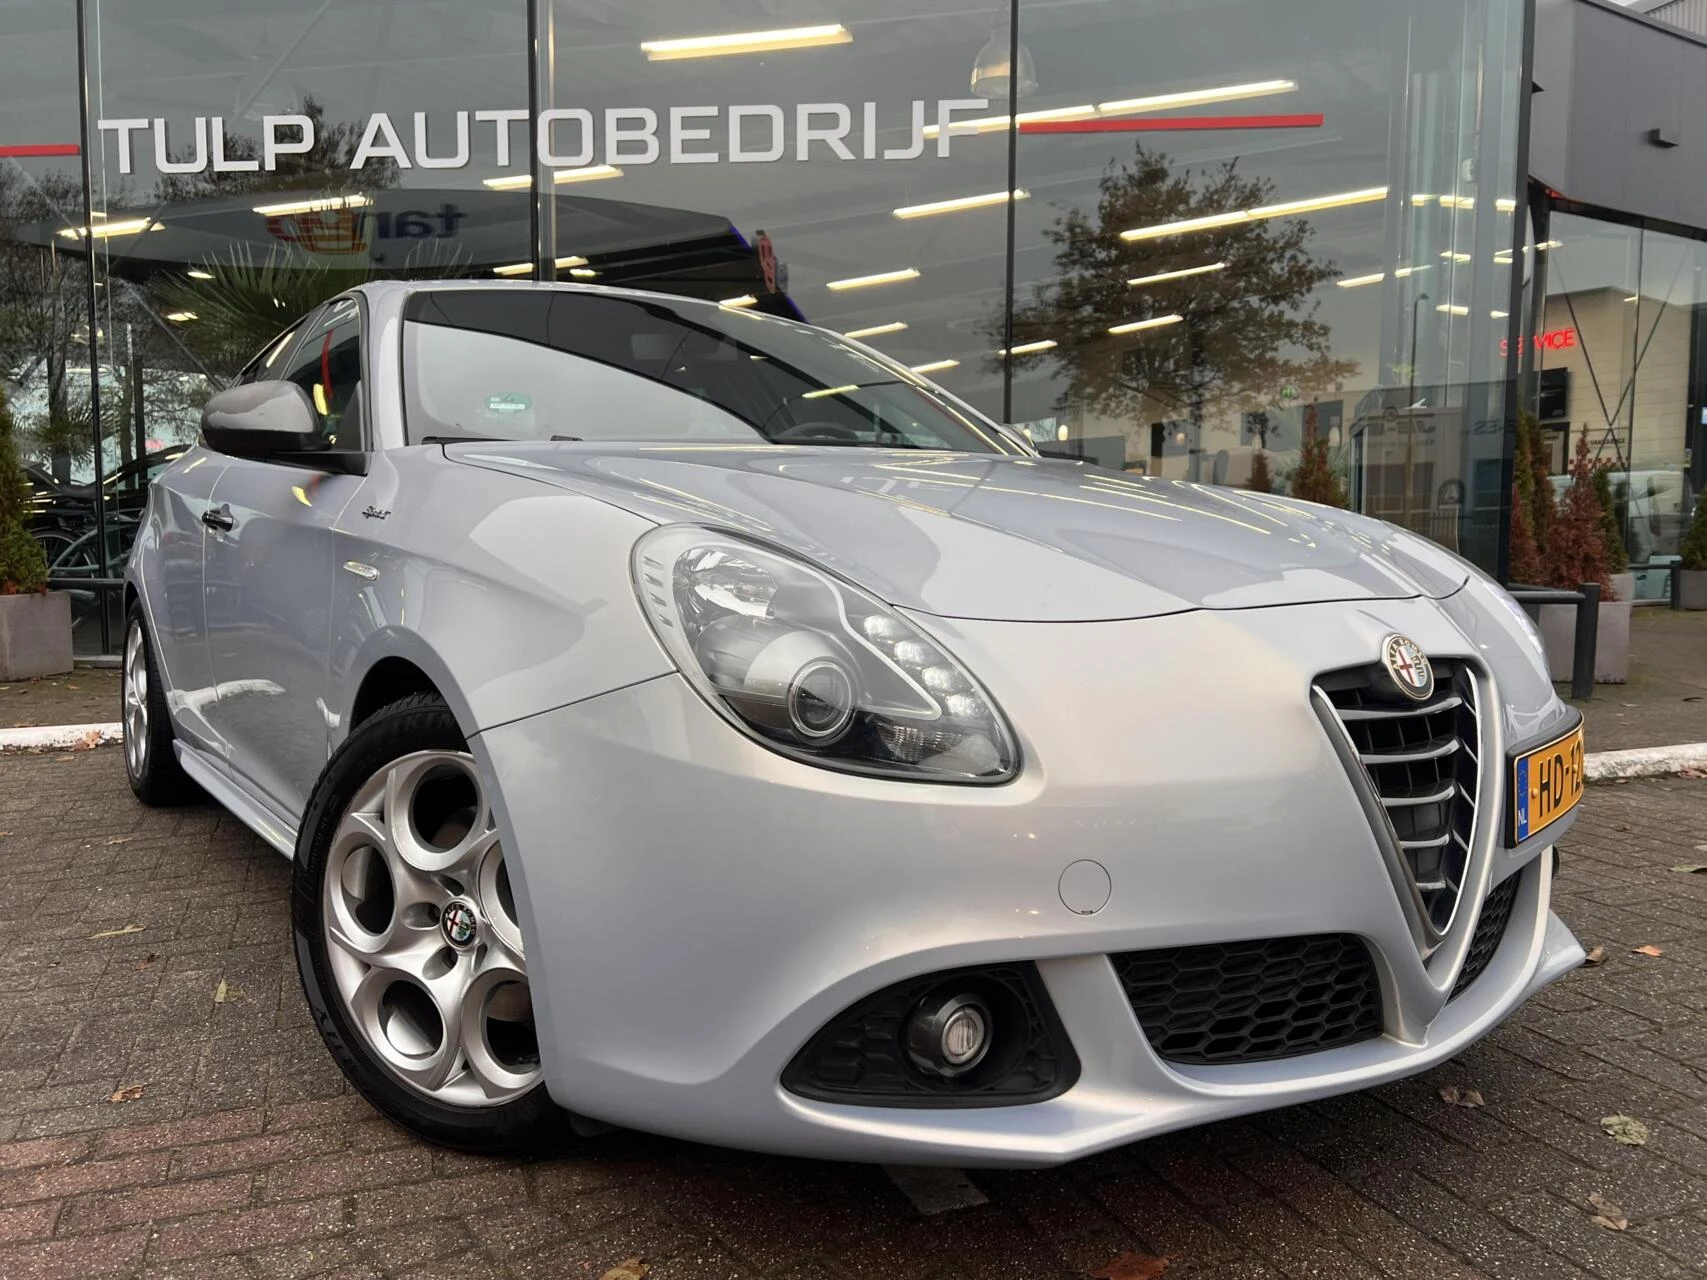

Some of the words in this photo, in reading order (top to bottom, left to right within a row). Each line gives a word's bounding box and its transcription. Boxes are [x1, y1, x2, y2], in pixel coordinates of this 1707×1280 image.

[98, 113, 315, 174] TULP
[350, 98, 989, 170] AUTOBEDRIJF
[1499, 328, 1577, 358] SEVICE
[1518, 807, 1528, 826] NL
